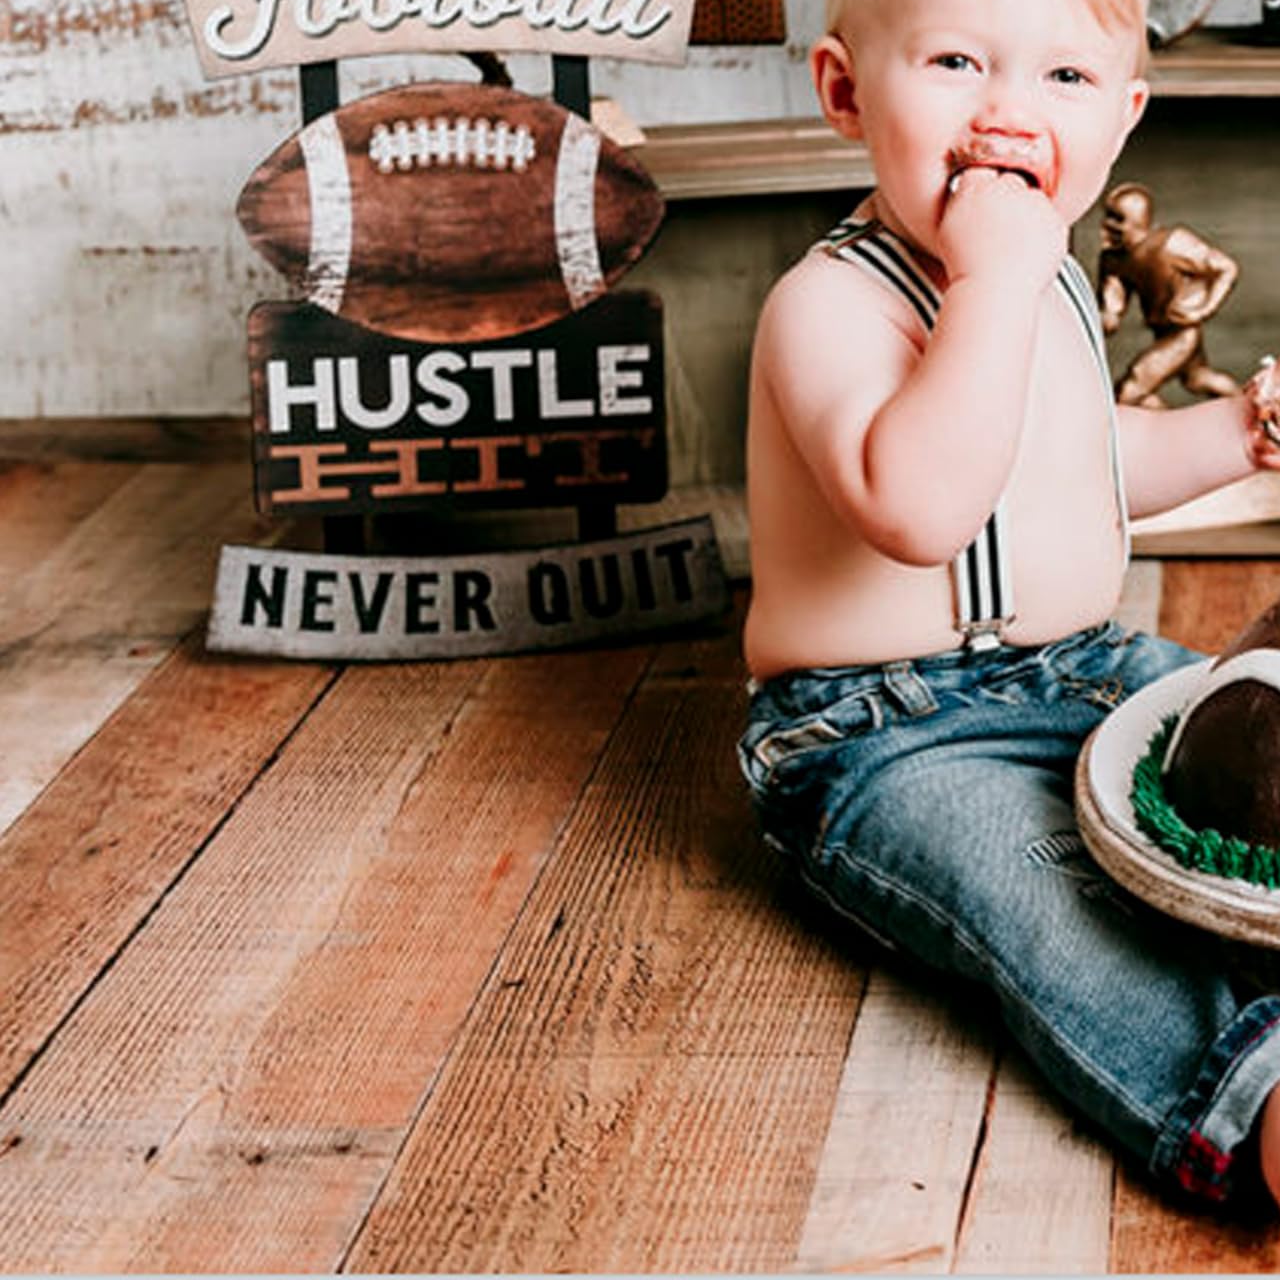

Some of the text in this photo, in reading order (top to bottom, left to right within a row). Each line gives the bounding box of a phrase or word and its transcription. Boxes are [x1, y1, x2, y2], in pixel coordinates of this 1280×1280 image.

[266, 345, 653, 433] HUSTLE
[270, 428, 656, 503] HIT
[240, 539, 695, 634] NEVER QUIT
